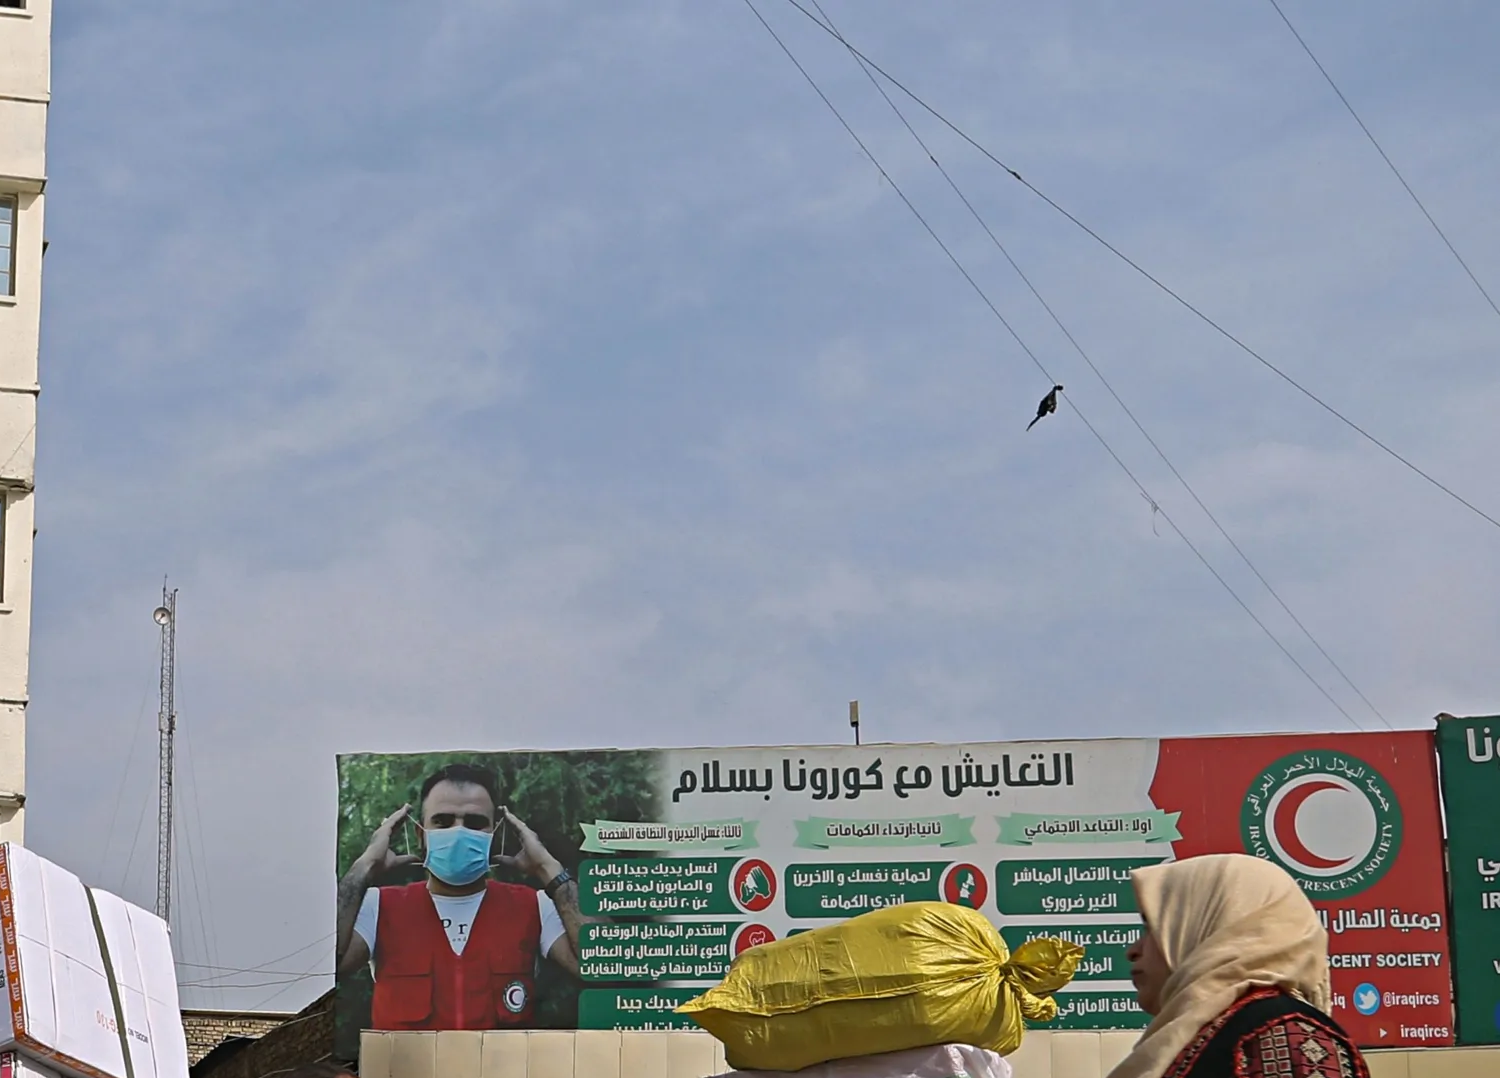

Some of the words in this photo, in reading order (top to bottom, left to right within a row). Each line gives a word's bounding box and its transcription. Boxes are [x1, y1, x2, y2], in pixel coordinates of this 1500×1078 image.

[672, 759, 773, 802] بسلام
[783, 758, 884, 800] كورونا
[893, 764, 932, 798] مع
[941, 753, 1074, 798] التعايش
[598, 827, 634, 841] الشخصية
[636, 826, 667, 841] النظافة
[674, 826, 700, 843] اليدين
[826, 823, 880, 837] الكمامات
[1024, 821, 1080, 840] الاجتماعي
[1364, 821, 1393, 875] SOCIETY
[588, 863, 622, 877] بالماء
[624, 864, 649, 878] جيدا
[651, 863, 683, 877] يديك
[684, 862, 718, 876] اغسل
[847, 869, 889, 883] نفسك
[891, 868, 931, 885] لحماية
[1012, 867, 1061, 886] المباشر
[1065, 867, 1110, 883] الاتصال
[792, 869, 834, 887] الاخرين
[626, 881, 653, 893] لمدة
[656, 880, 703, 895] الصابون
[598, 898, 647, 912] باستمرار
[649, 897, 678, 911] ثانية
[692, 898, 709, 910] عن
[820, 894, 868, 909] الكمامة
[1041, 895, 1084, 912] ضروري
[1087, 893, 1117, 912] الغير
[1333, 909, 1385, 933] الهلال
[1390, 909, 1442, 932] جمعية
[601, 926, 639, 940] الورقية
[640, 925, 683, 940] المناديل
[685, 924, 727, 939] استخدم
[1094, 929, 1141, 947] الابتعاد
[581, 945, 622, 958] العطاس
[636, 945, 673, 959] السعال
[675, 944, 698, 957] اثناء
[699, 943, 727, 957] الكوع
[1376, 953, 1442, 968] SOCIETY
[580, 963, 623, 976] النفايات
[624, 964, 649, 976] كيس
[650, 964, 667, 980] في
[668, 963, 692, 975] منها
[694, 962, 723, 975] تخلص
[616, 996, 642, 1013] جيدا
[1077, 998, 1110, 1016] الامان
[1383, 992, 1440, 1009] @iraqircs
[1400, 1025, 1449, 1041] iraqircs
